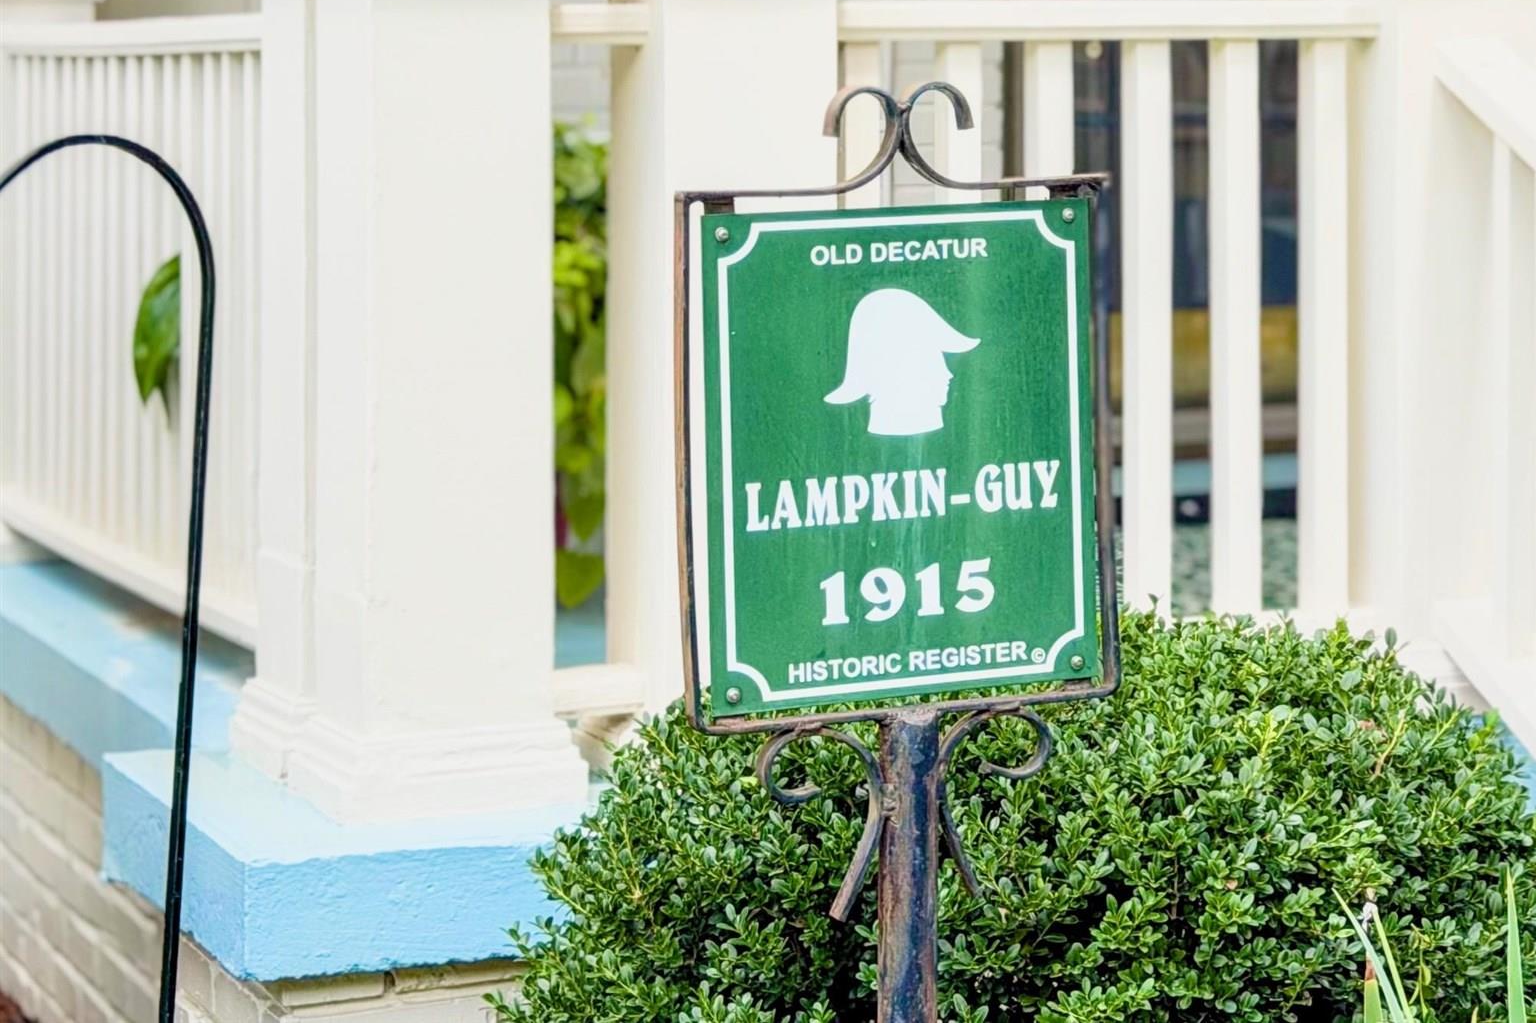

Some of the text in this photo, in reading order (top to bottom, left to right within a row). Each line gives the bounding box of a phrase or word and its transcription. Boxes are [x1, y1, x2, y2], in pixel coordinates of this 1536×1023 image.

[809, 237, 988, 266] OLD DECATUR
[745, 460, 1060, 532] LAMPKIN-GUY
[819, 557, 996, 626] 1915
[788, 653, 902, 684] HISTORIC
[907, 641, 1027, 673] REGISTER
